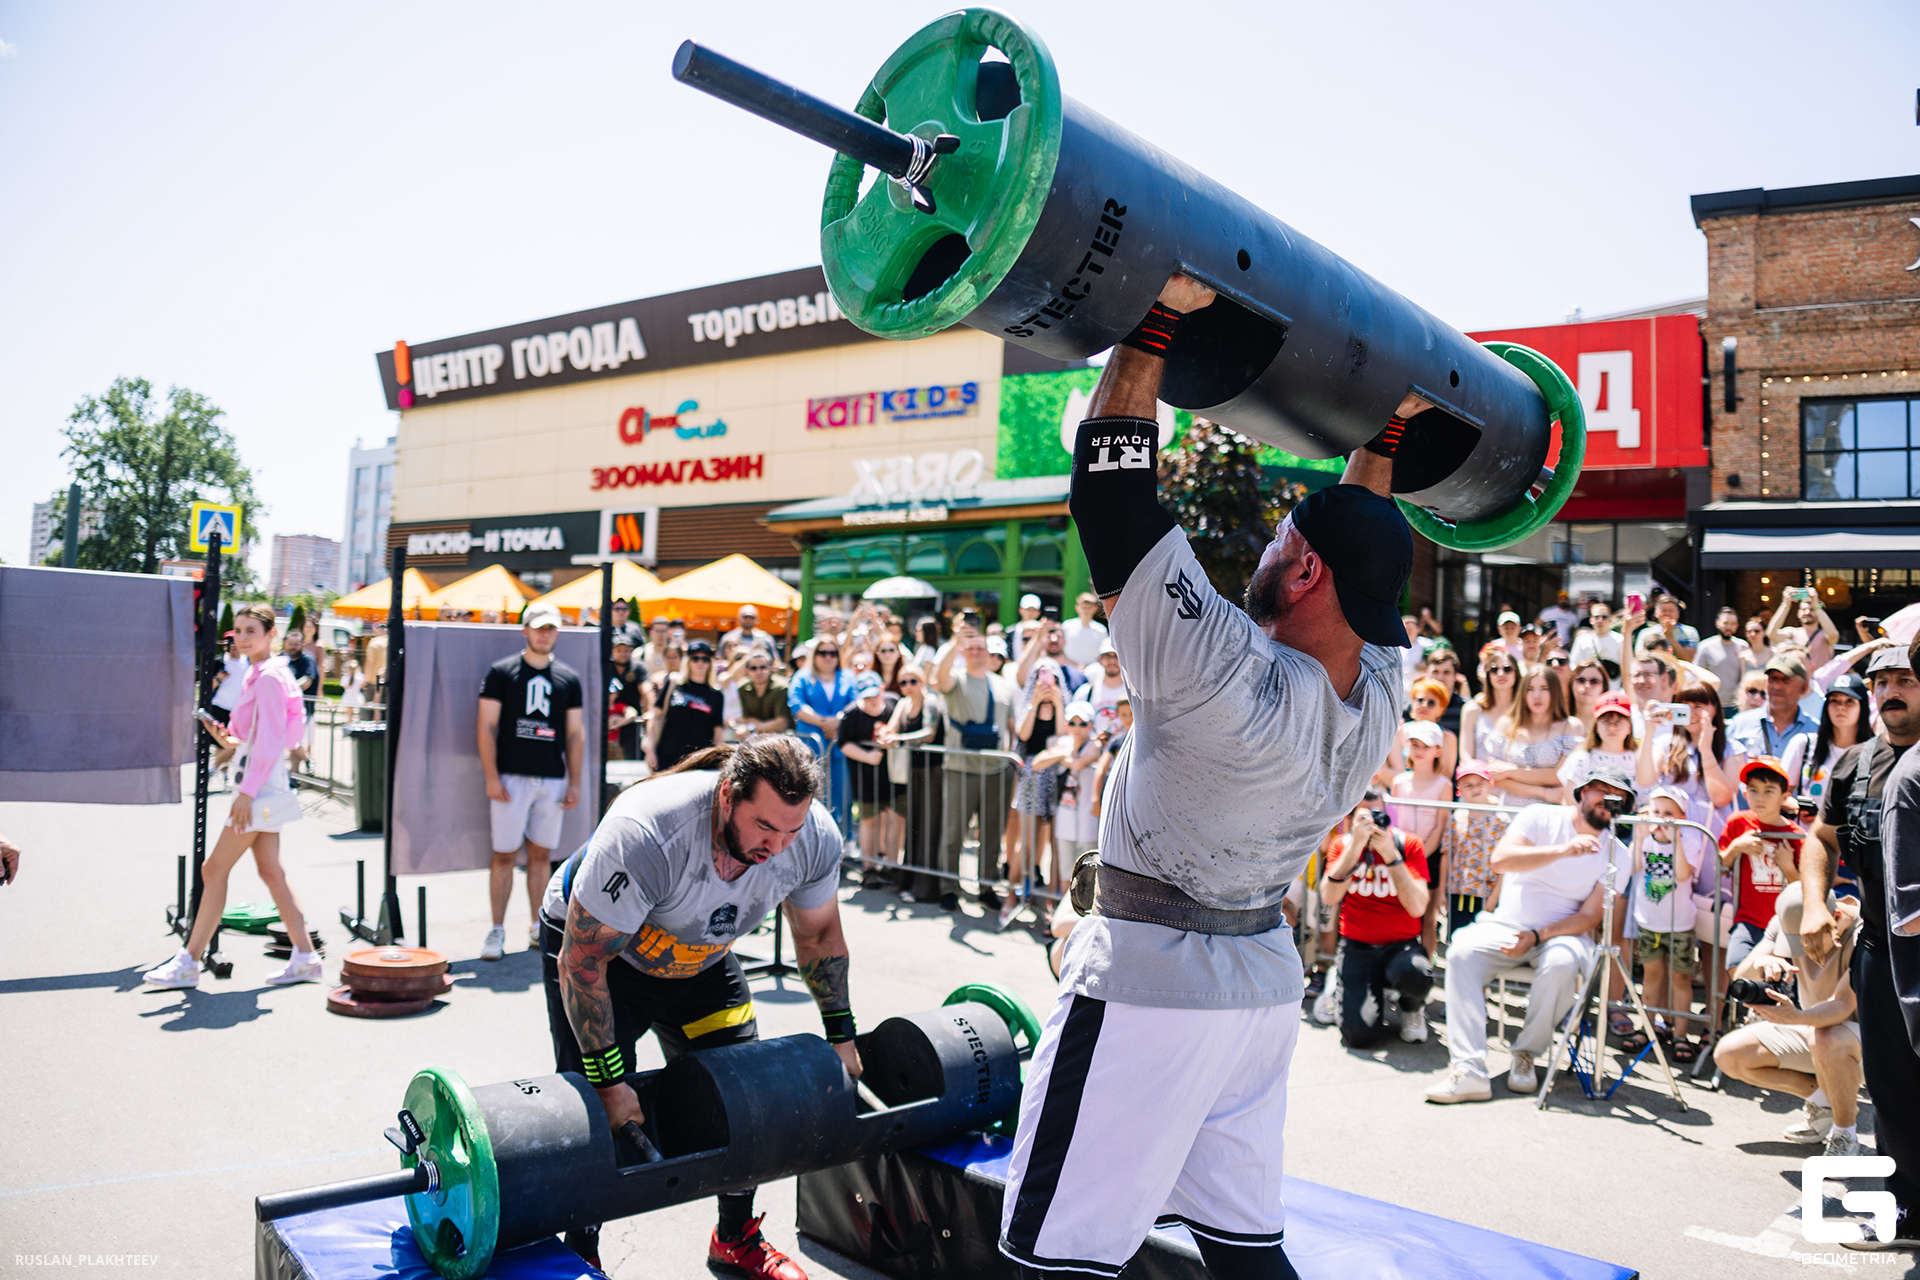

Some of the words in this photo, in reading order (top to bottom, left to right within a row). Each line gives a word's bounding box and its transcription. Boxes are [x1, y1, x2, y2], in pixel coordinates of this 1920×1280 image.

[860, 205, 891, 257] 25KG
[1003, 197, 1128, 339] STECTER
[411, 342, 505, 399] ЦЕНТР
[511, 317, 647, 381] ГОРОДА
[806, 392, 877, 431] kari
[1578, 350, 1641, 448] Д
[1088, 446, 1150, 472] RT
[1091, 435, 1150, 446] POWER
[590, 454, 764, 491] ЗООМАГАЗИН
[502, 526, 565, 552] ТОЧКА
[953, 1017, 991, 1106] STECTER
